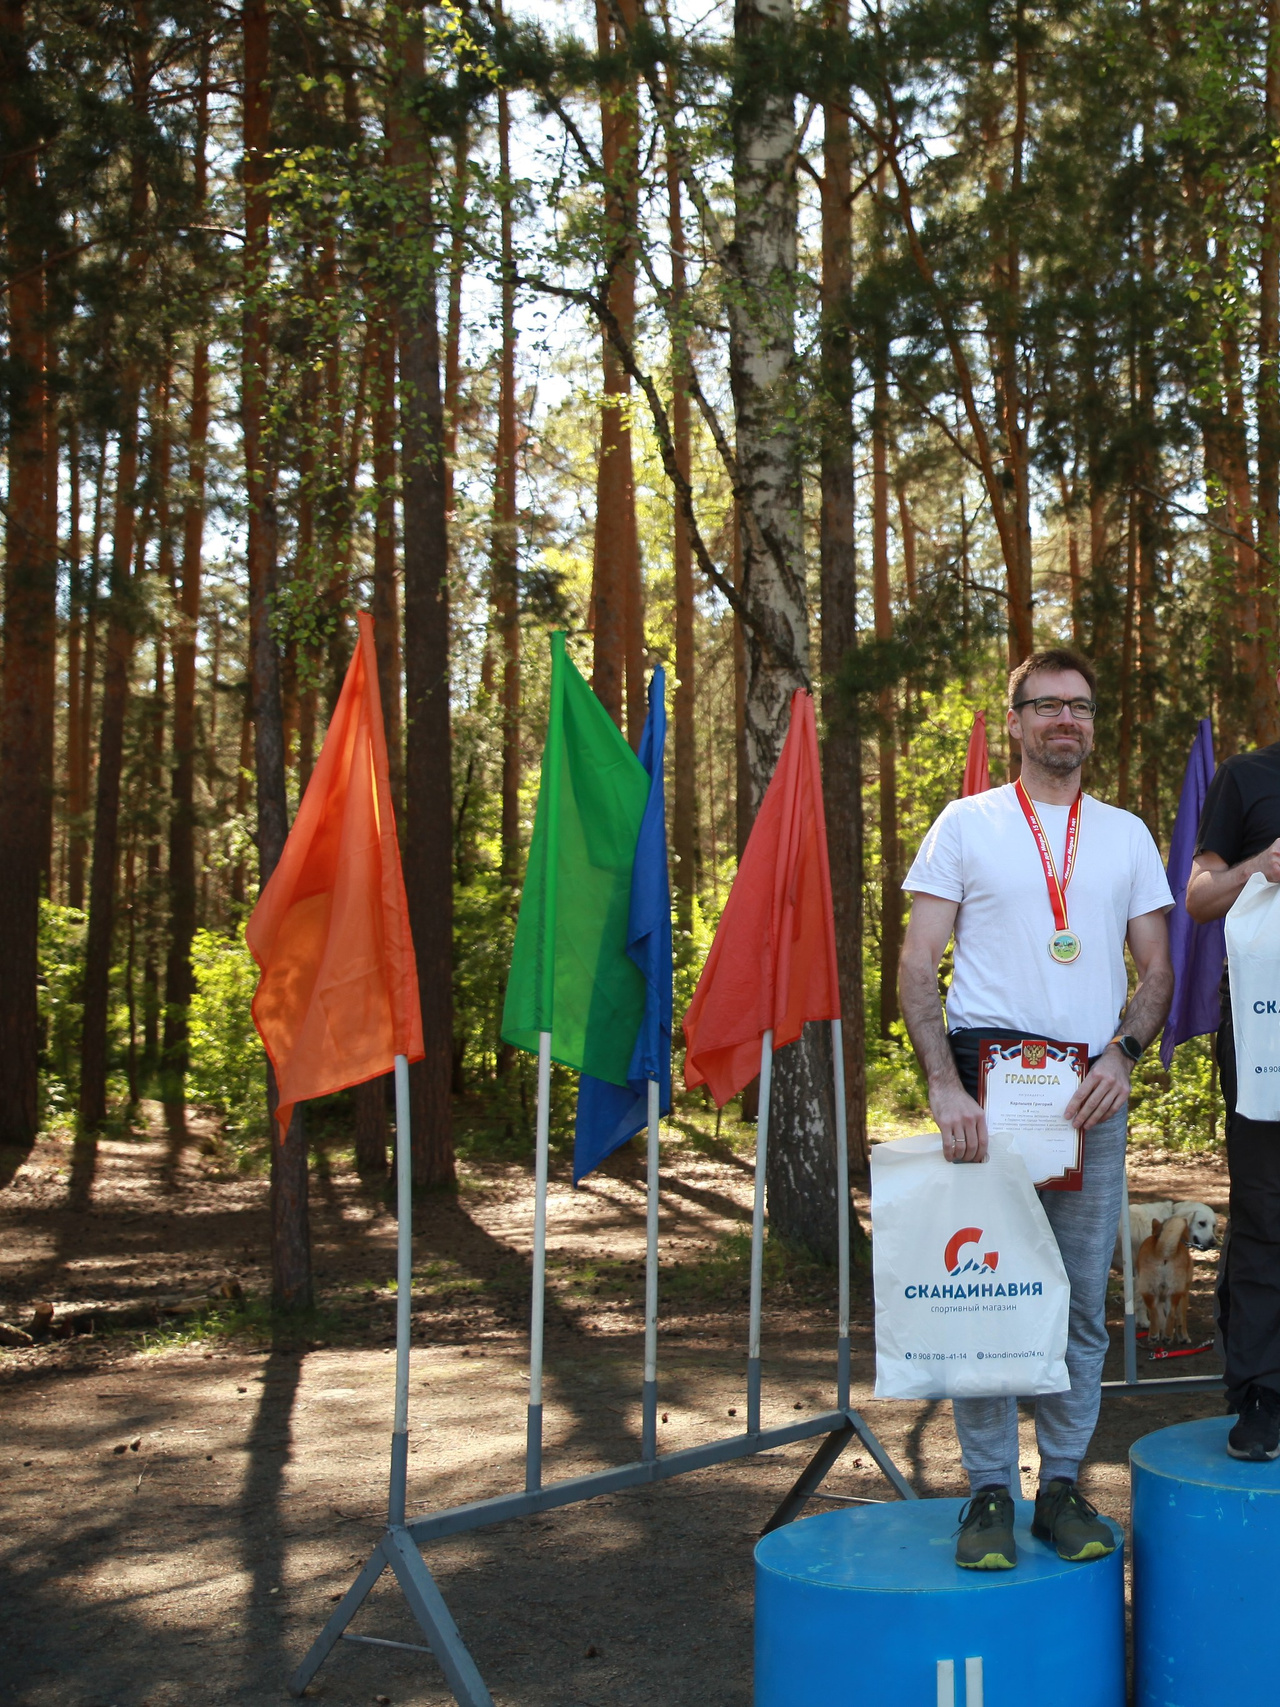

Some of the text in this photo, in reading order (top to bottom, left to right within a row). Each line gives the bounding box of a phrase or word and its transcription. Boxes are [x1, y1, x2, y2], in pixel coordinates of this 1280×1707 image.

[1005, 1074, 1061, 1085] ГРАМОТА
[904, 1282, 1043, 1299] СКАНДИНАВИЯ
[930, 1304, 1017, 1315] спортивный магазин
[932, 1353, 967, 1361] 708-41-14
[984, 1351, 1045, 1360] skandinavia74.ru
